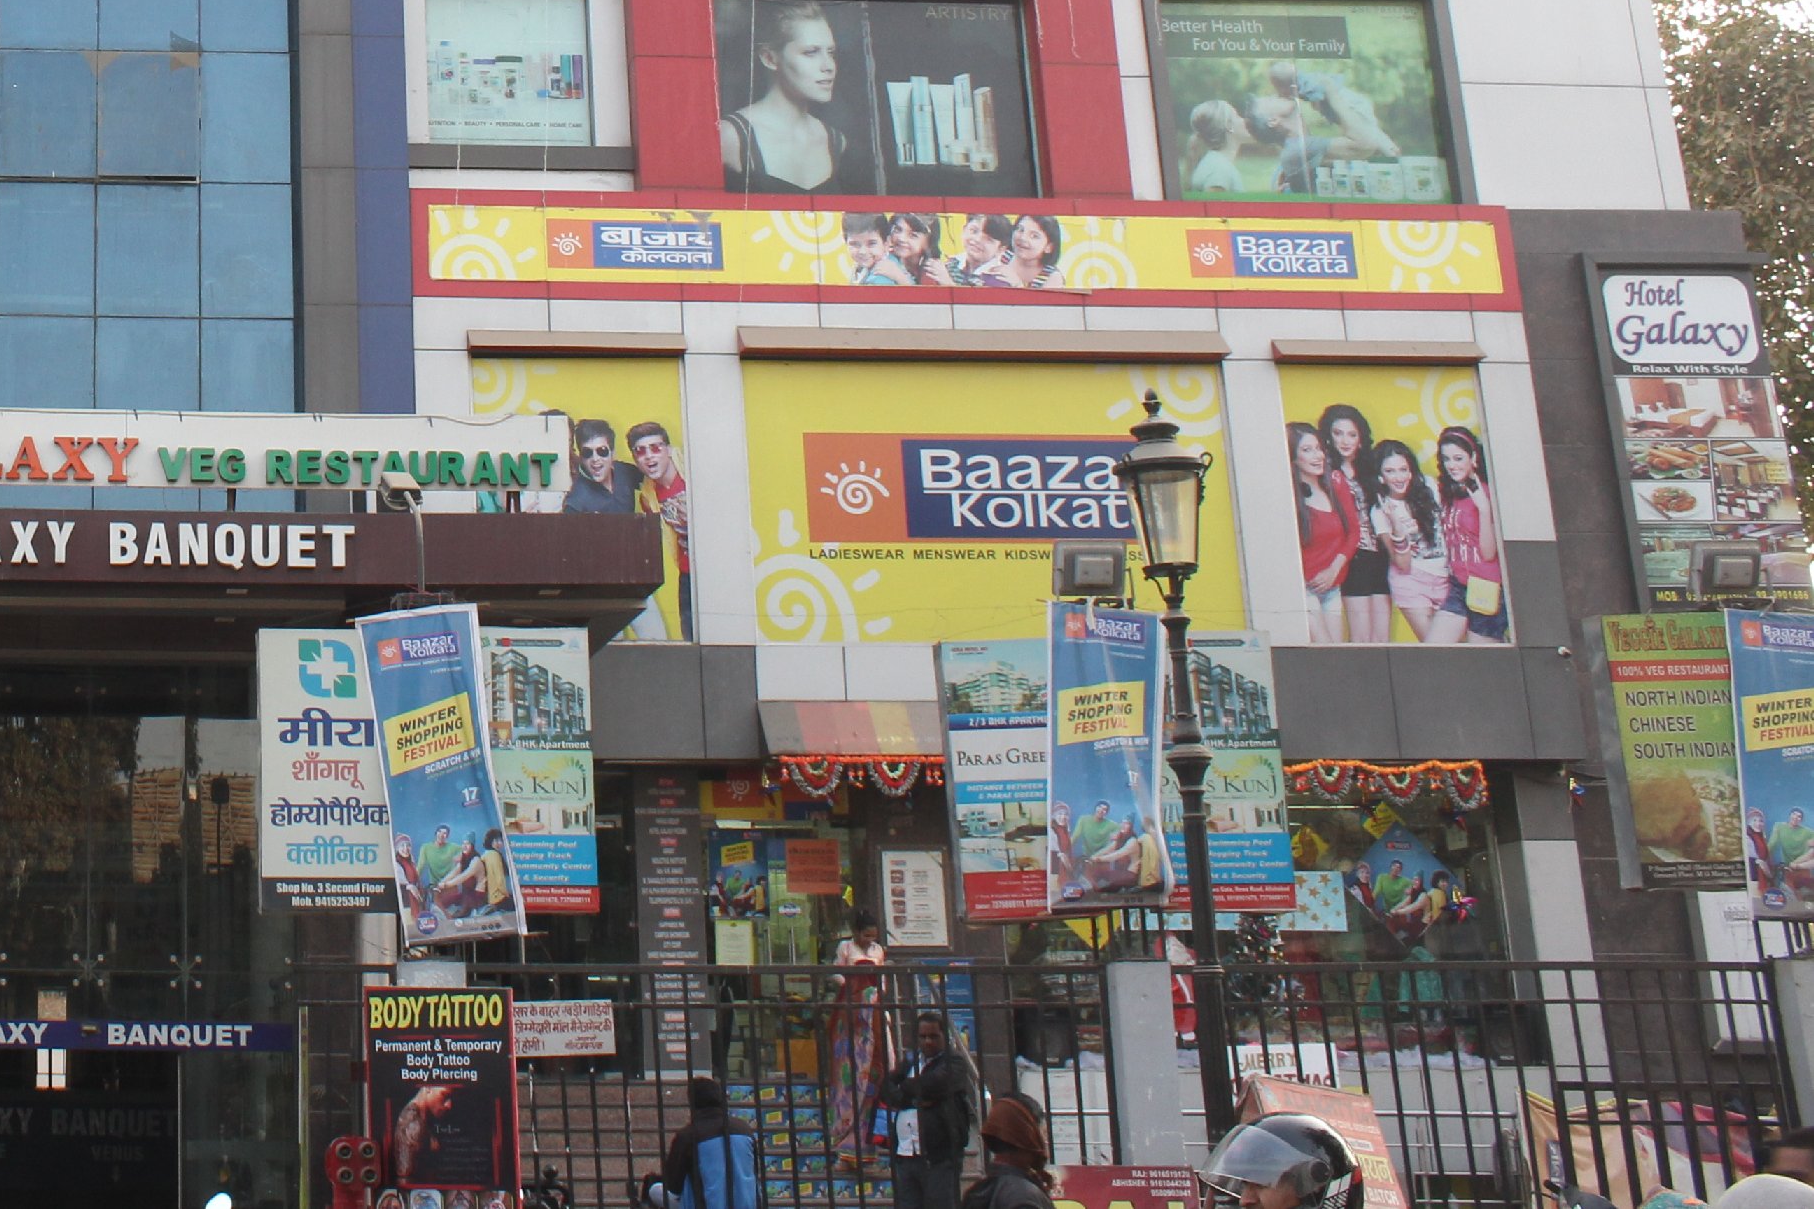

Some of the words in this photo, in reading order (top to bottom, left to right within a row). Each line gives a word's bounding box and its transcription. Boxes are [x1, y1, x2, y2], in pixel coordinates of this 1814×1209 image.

[925, 6, 1009, 21] ARTISTRY
[1162, 19, 1207, 33] Better
[1212, 19, 1262, 33] Health
[1193, 39, 1215, 51] For
[1219, 39, 1245, 51] You
[1263, 40, 1295, 51] Your
[1299, 39, 1345, 54] Family
[1236, 235, 1346, 256] Baazar
[1252, 254, 1348, 274] Kolkata
[1625, 279, 1684, 307] Hotel
[1616, 311, 1749, 356] Galaxy
[1632, 364, 1670, 374] Relax
[1713, 364, 1748, 375] Style
[157, 447, 246, 483] VEG
[951, 492, 1131, 529] Kolkat
[109, 522, 356, 570] BANQUET
[809, 549, 904, 560] LADIESWEAR
[913, 549, 995, 560] MENSWEAR
[1667, 665, 1729, 675] RESTAURANT
[1626, 691, 1676, 706] NORTH
[278, 708, 374, 746] मीरा
[400, 706, 457, 734] WINTER
[1074, 717, 1128, 734] FESTIVAL
[1630, 717, 1696, 732] CHINESE
[397, 717, 463, 750] SHOPPING
[404, 734, 462, 763] FESTIVAL
[539, 740, 590, 749] Apartment
[1228, 740, 1276, 748] Apartment
[1634, 743, 1686, 759] SOUTH
[425, 756, 461, 773] SCRATCH
[957, 749, 1002, 766] PARAS
[533, 776, 586, 800] KUNJ
[1223, 775, 1276, 798] KUNJ
[286, 836, 379, 865] क्लीनिक
[276, 882, 298, 895] Shop
[326, 882, 359, 893] Second
[315, 896, 370, 907] 9415253497
[369, 995, 424, 1029] BODY
[428, 993, 503, 1028] TATTOO
[108, 1024, 252, 1046] BANQUET
[375, 1041, 432, 1052] Permanent
[445, 1041, 502, 1053] Temporary
[437, 1055, 470, 1065] Tattoo
